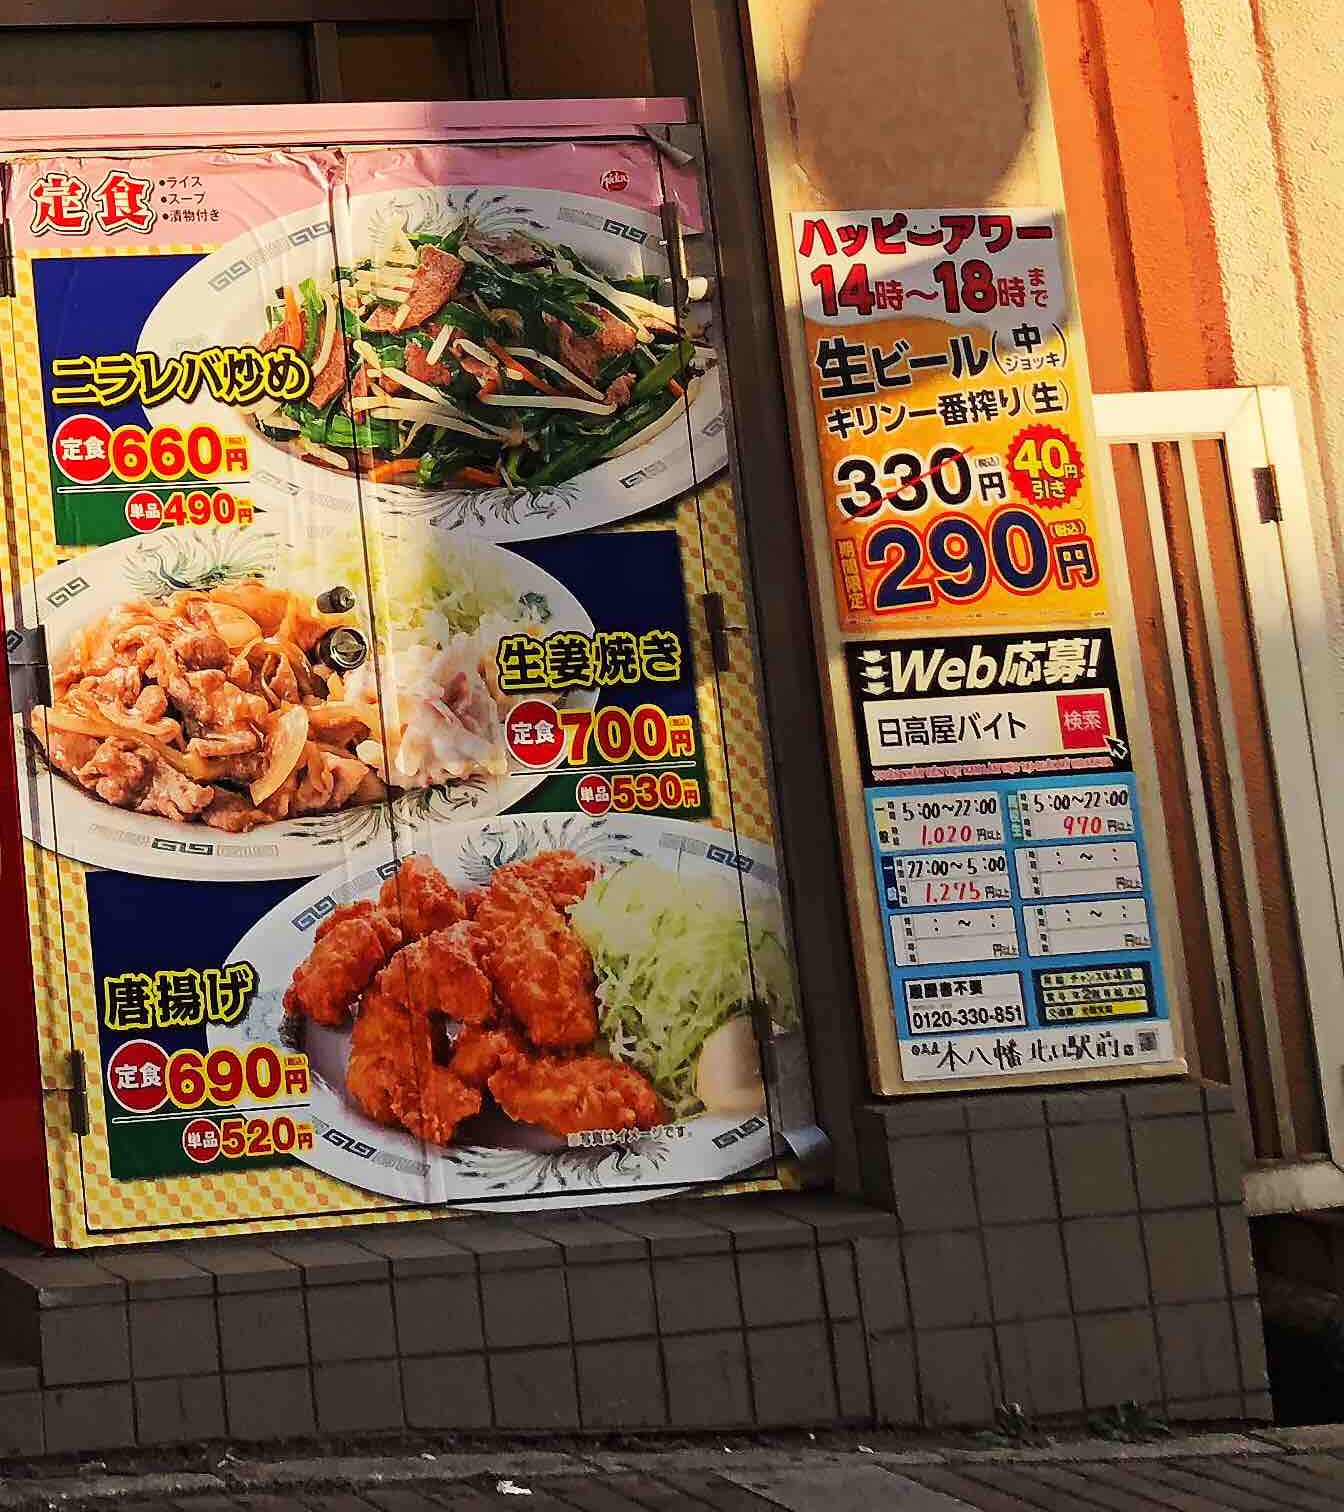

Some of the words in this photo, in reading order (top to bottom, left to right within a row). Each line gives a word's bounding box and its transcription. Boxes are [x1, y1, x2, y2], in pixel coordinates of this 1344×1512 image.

[29, 170, 157, 236] 定食
[166, 176, 203, 189] ライス
[168, 191, 207, 205] スープ
[169, 208, 221, 223] 漬物付き
[799, 213, 1053, 257] ハッピーアワー
[52, 346, 312, 406] ニラレバ炒め
[816, 334, 989, 399] 生ビール
[60, 436, 106, 461] 定食
[108, 423, 249, 481] 660円
[129, 503, 161, 519] 単品
[163, 490, 254, 526] 490円
[1031, 479, 1066, 501] 引き
[497, 631, 682, 694] 生姜焼き
[889, 638, 1102, 694] Web応募!
[511, 719, 555, 745] 定食
[558, 704, 696, 766] 700円
[877, 711, 1027, 748] 日高屋バイト
[1062, 709, 1103, 733] 検索
[580, 784, 610, 804] 単品
[611, 772, 701, 811] 530円
[104, 962, 256, 1030] 唐揚げ
[913, 1004, 1023, 1030] 0120-330-851
[114, 1062, 162, 1090] 定食
[165, 1044, 311, 1110] 690円
[187, 1131, 218, 1150] 単品
[220, 1116, 315, 1158] 520円
